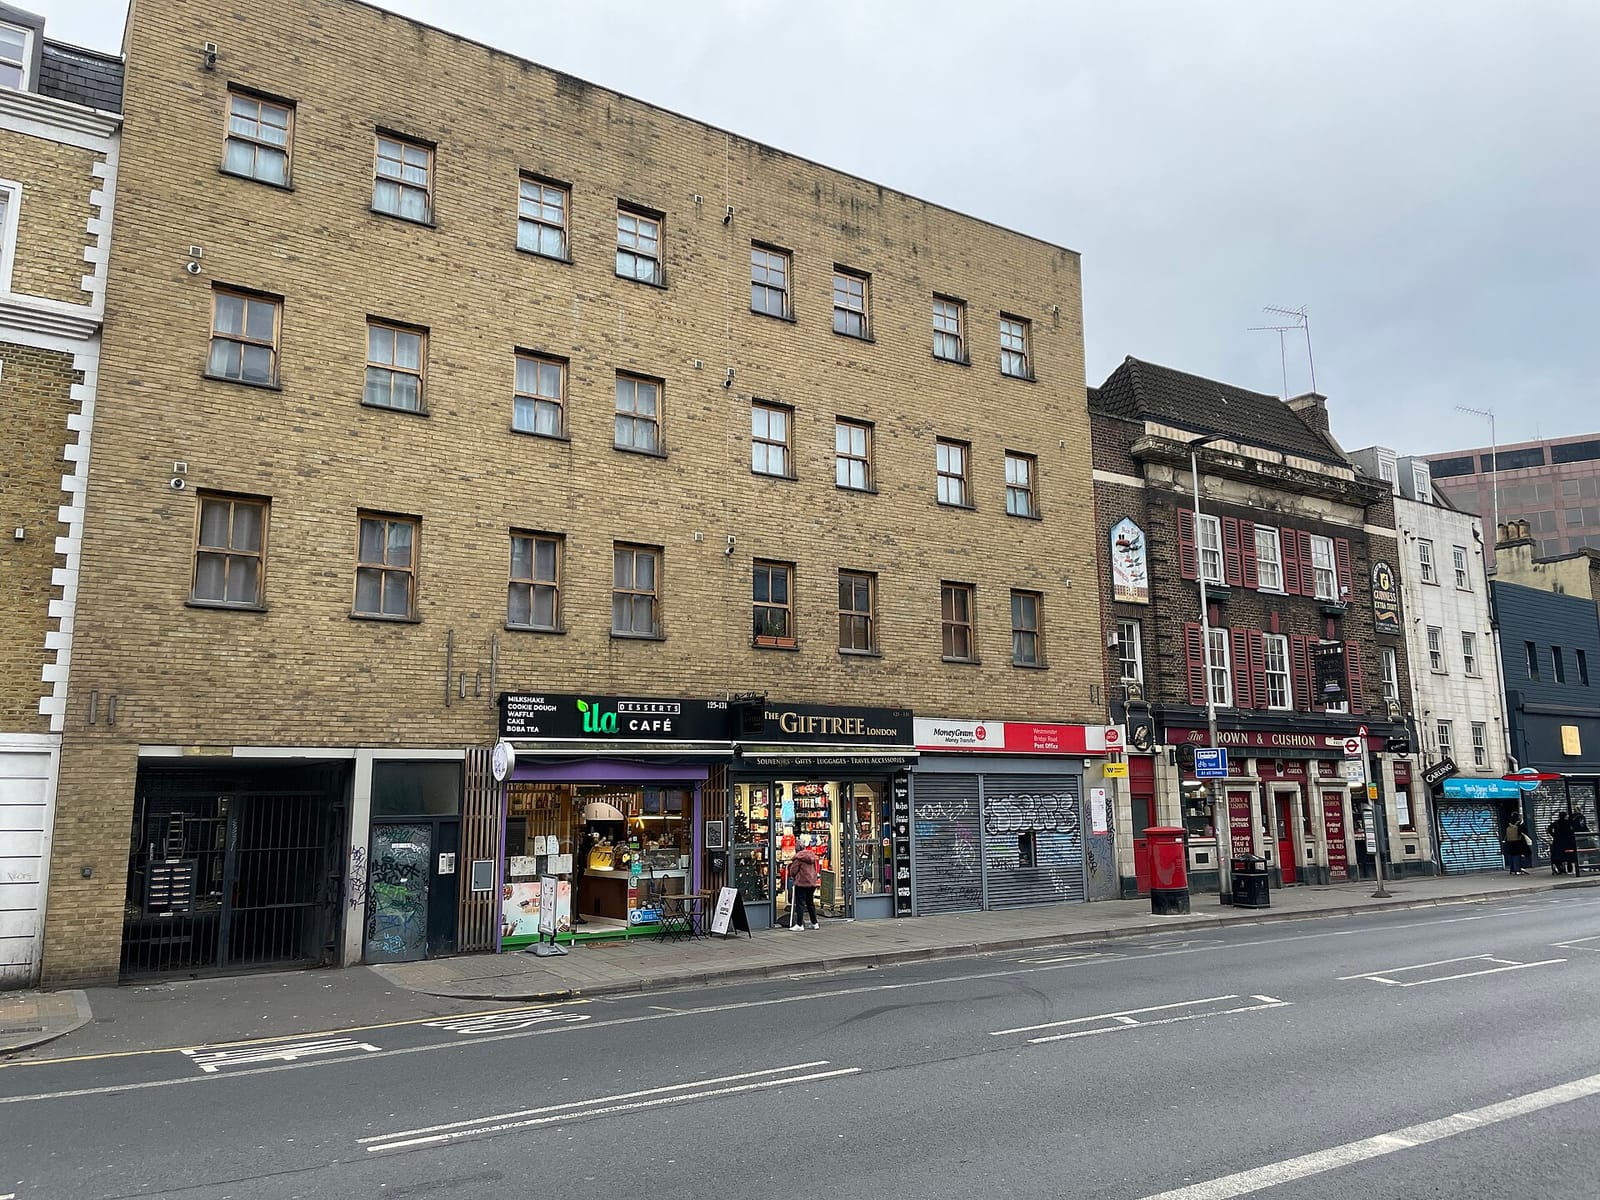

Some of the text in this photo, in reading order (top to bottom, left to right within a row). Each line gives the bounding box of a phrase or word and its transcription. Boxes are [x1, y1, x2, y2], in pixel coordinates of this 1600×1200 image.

[507, 696, 545, 704] MILKSHAKE
[507, 703, 533, 711] COOKIE
[619, 704, 679, 712] DESSERTS
[629, 718, 672, 731] CAFÉ
[779, 712, 866, 735] GIFTREE
[866, 727, 897, 736] LONDON
[933, 728, 974, 738] MoneyGram
[1358, 726, 1367, 736] A
[1187, 730, 1316, 747] The ROWN & CUSHION
[1425, 763, 1453, 783] CARLING
